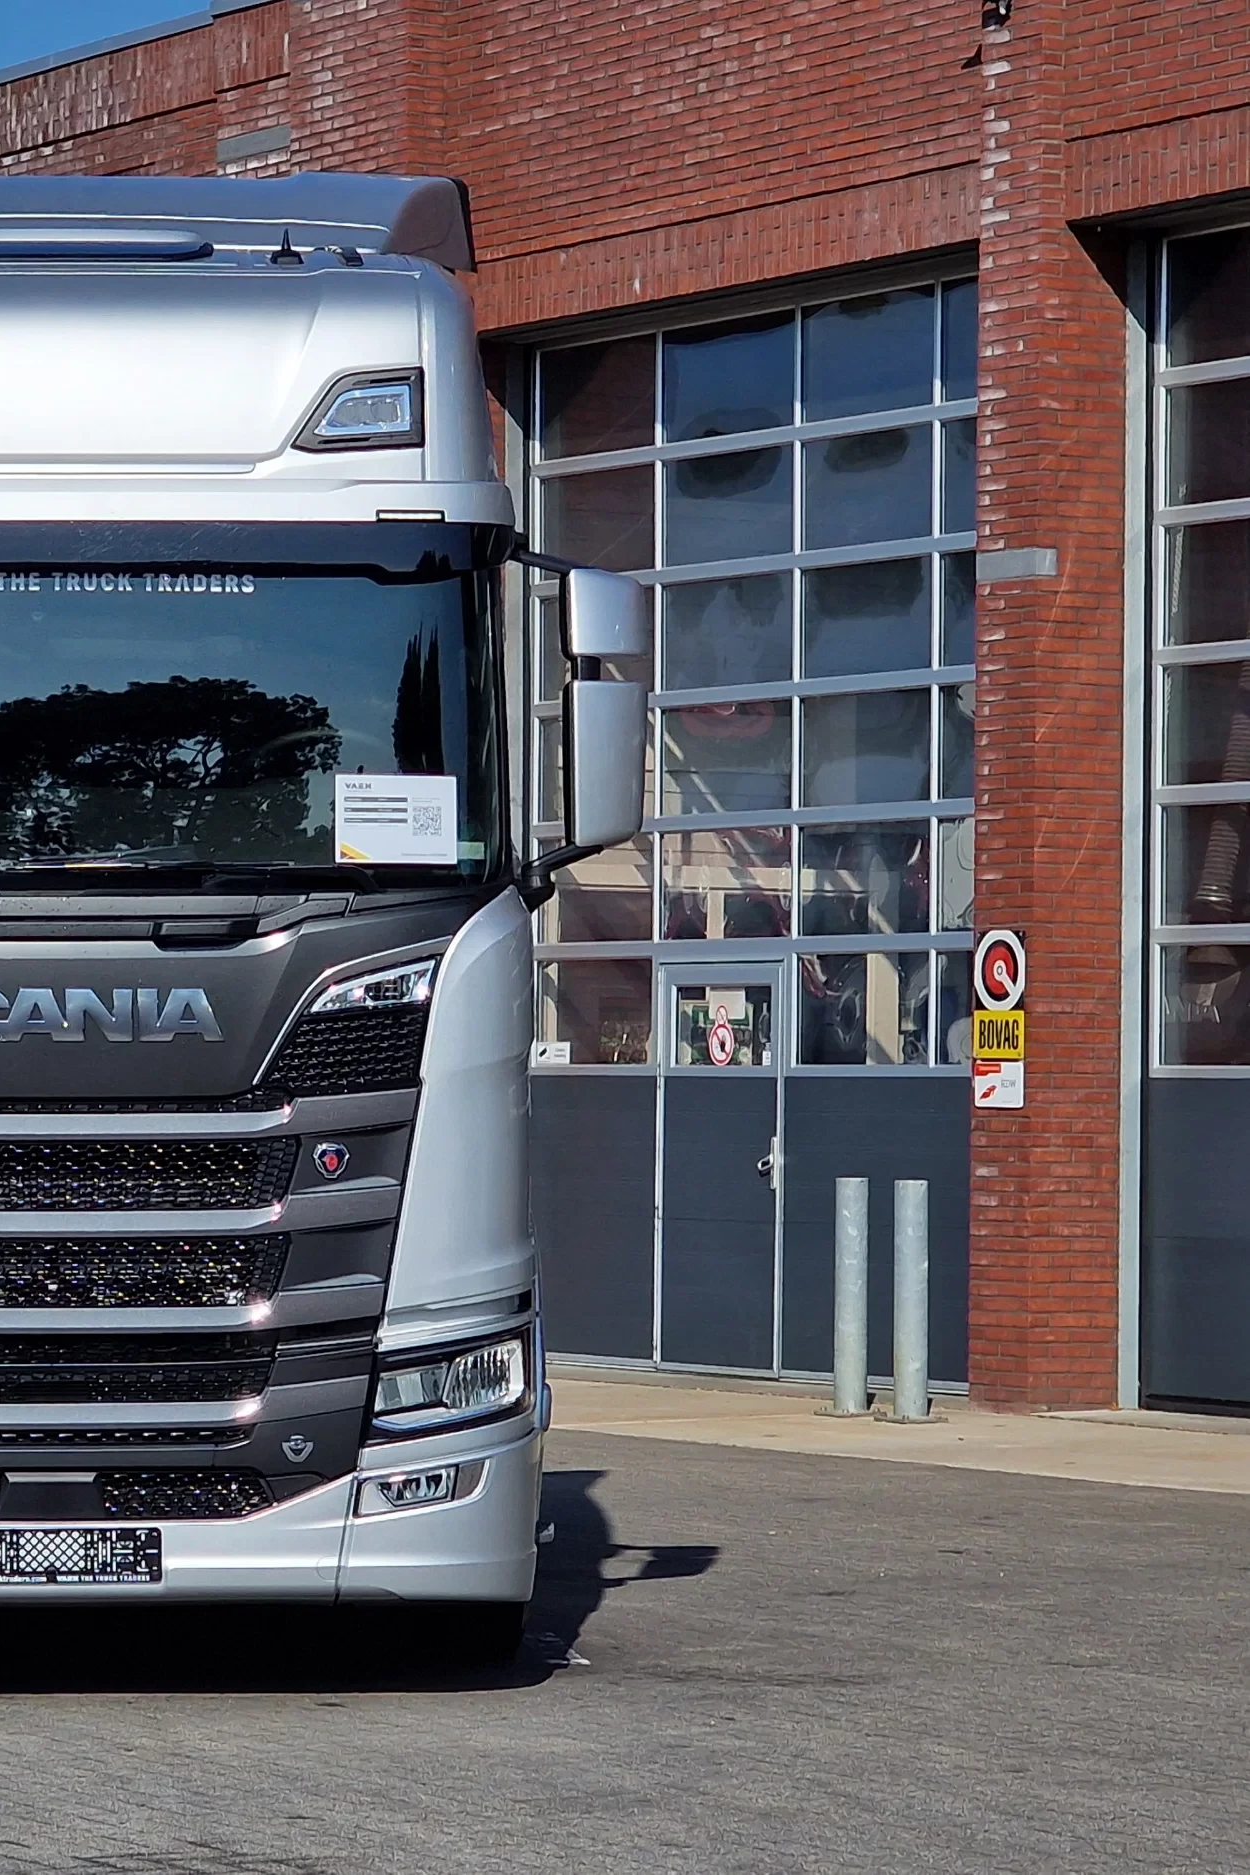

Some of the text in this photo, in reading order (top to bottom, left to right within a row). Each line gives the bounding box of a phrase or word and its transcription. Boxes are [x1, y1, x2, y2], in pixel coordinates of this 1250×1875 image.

[52, 572, 133, 592] TRUCK
[143, 572, 256, 593] TRADERS
[978, 1019, 1019, 1050] BOVAG
